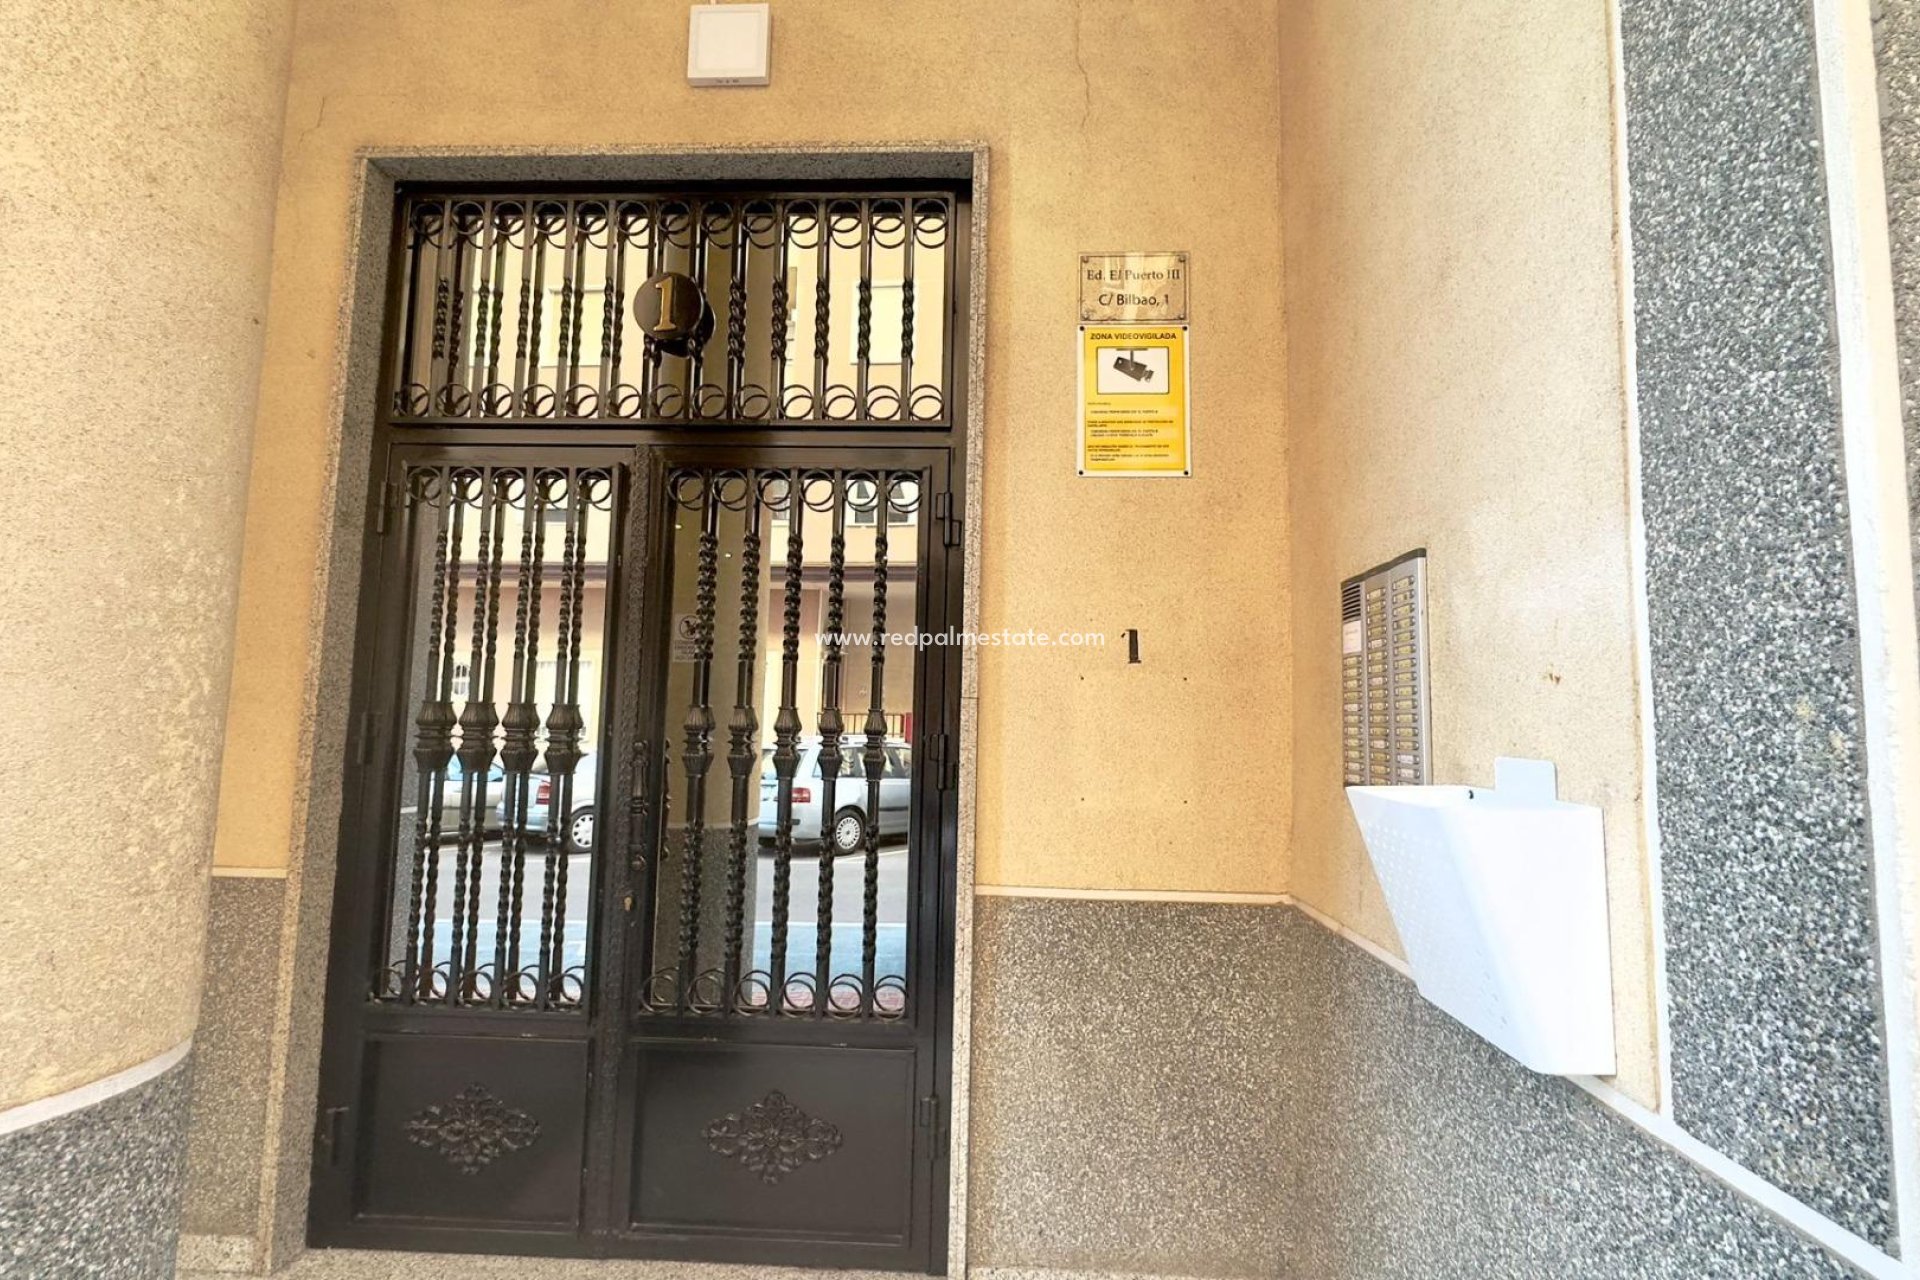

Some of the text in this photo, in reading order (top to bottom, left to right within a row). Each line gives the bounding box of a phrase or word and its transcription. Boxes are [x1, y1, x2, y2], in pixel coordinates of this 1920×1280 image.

[1087, 269, 1105, 281] Ed.
[1124, 269, 1163, 281] Puerto
[1167, 269, 1181, 280] III
[653, 276, 677, 332] 1
[1098, 293, 1113, 306] C/
[1117, 294, 1160, 307] Bilbao,
[1114, 332, 1177, 340] VIDEOVIGILADA
